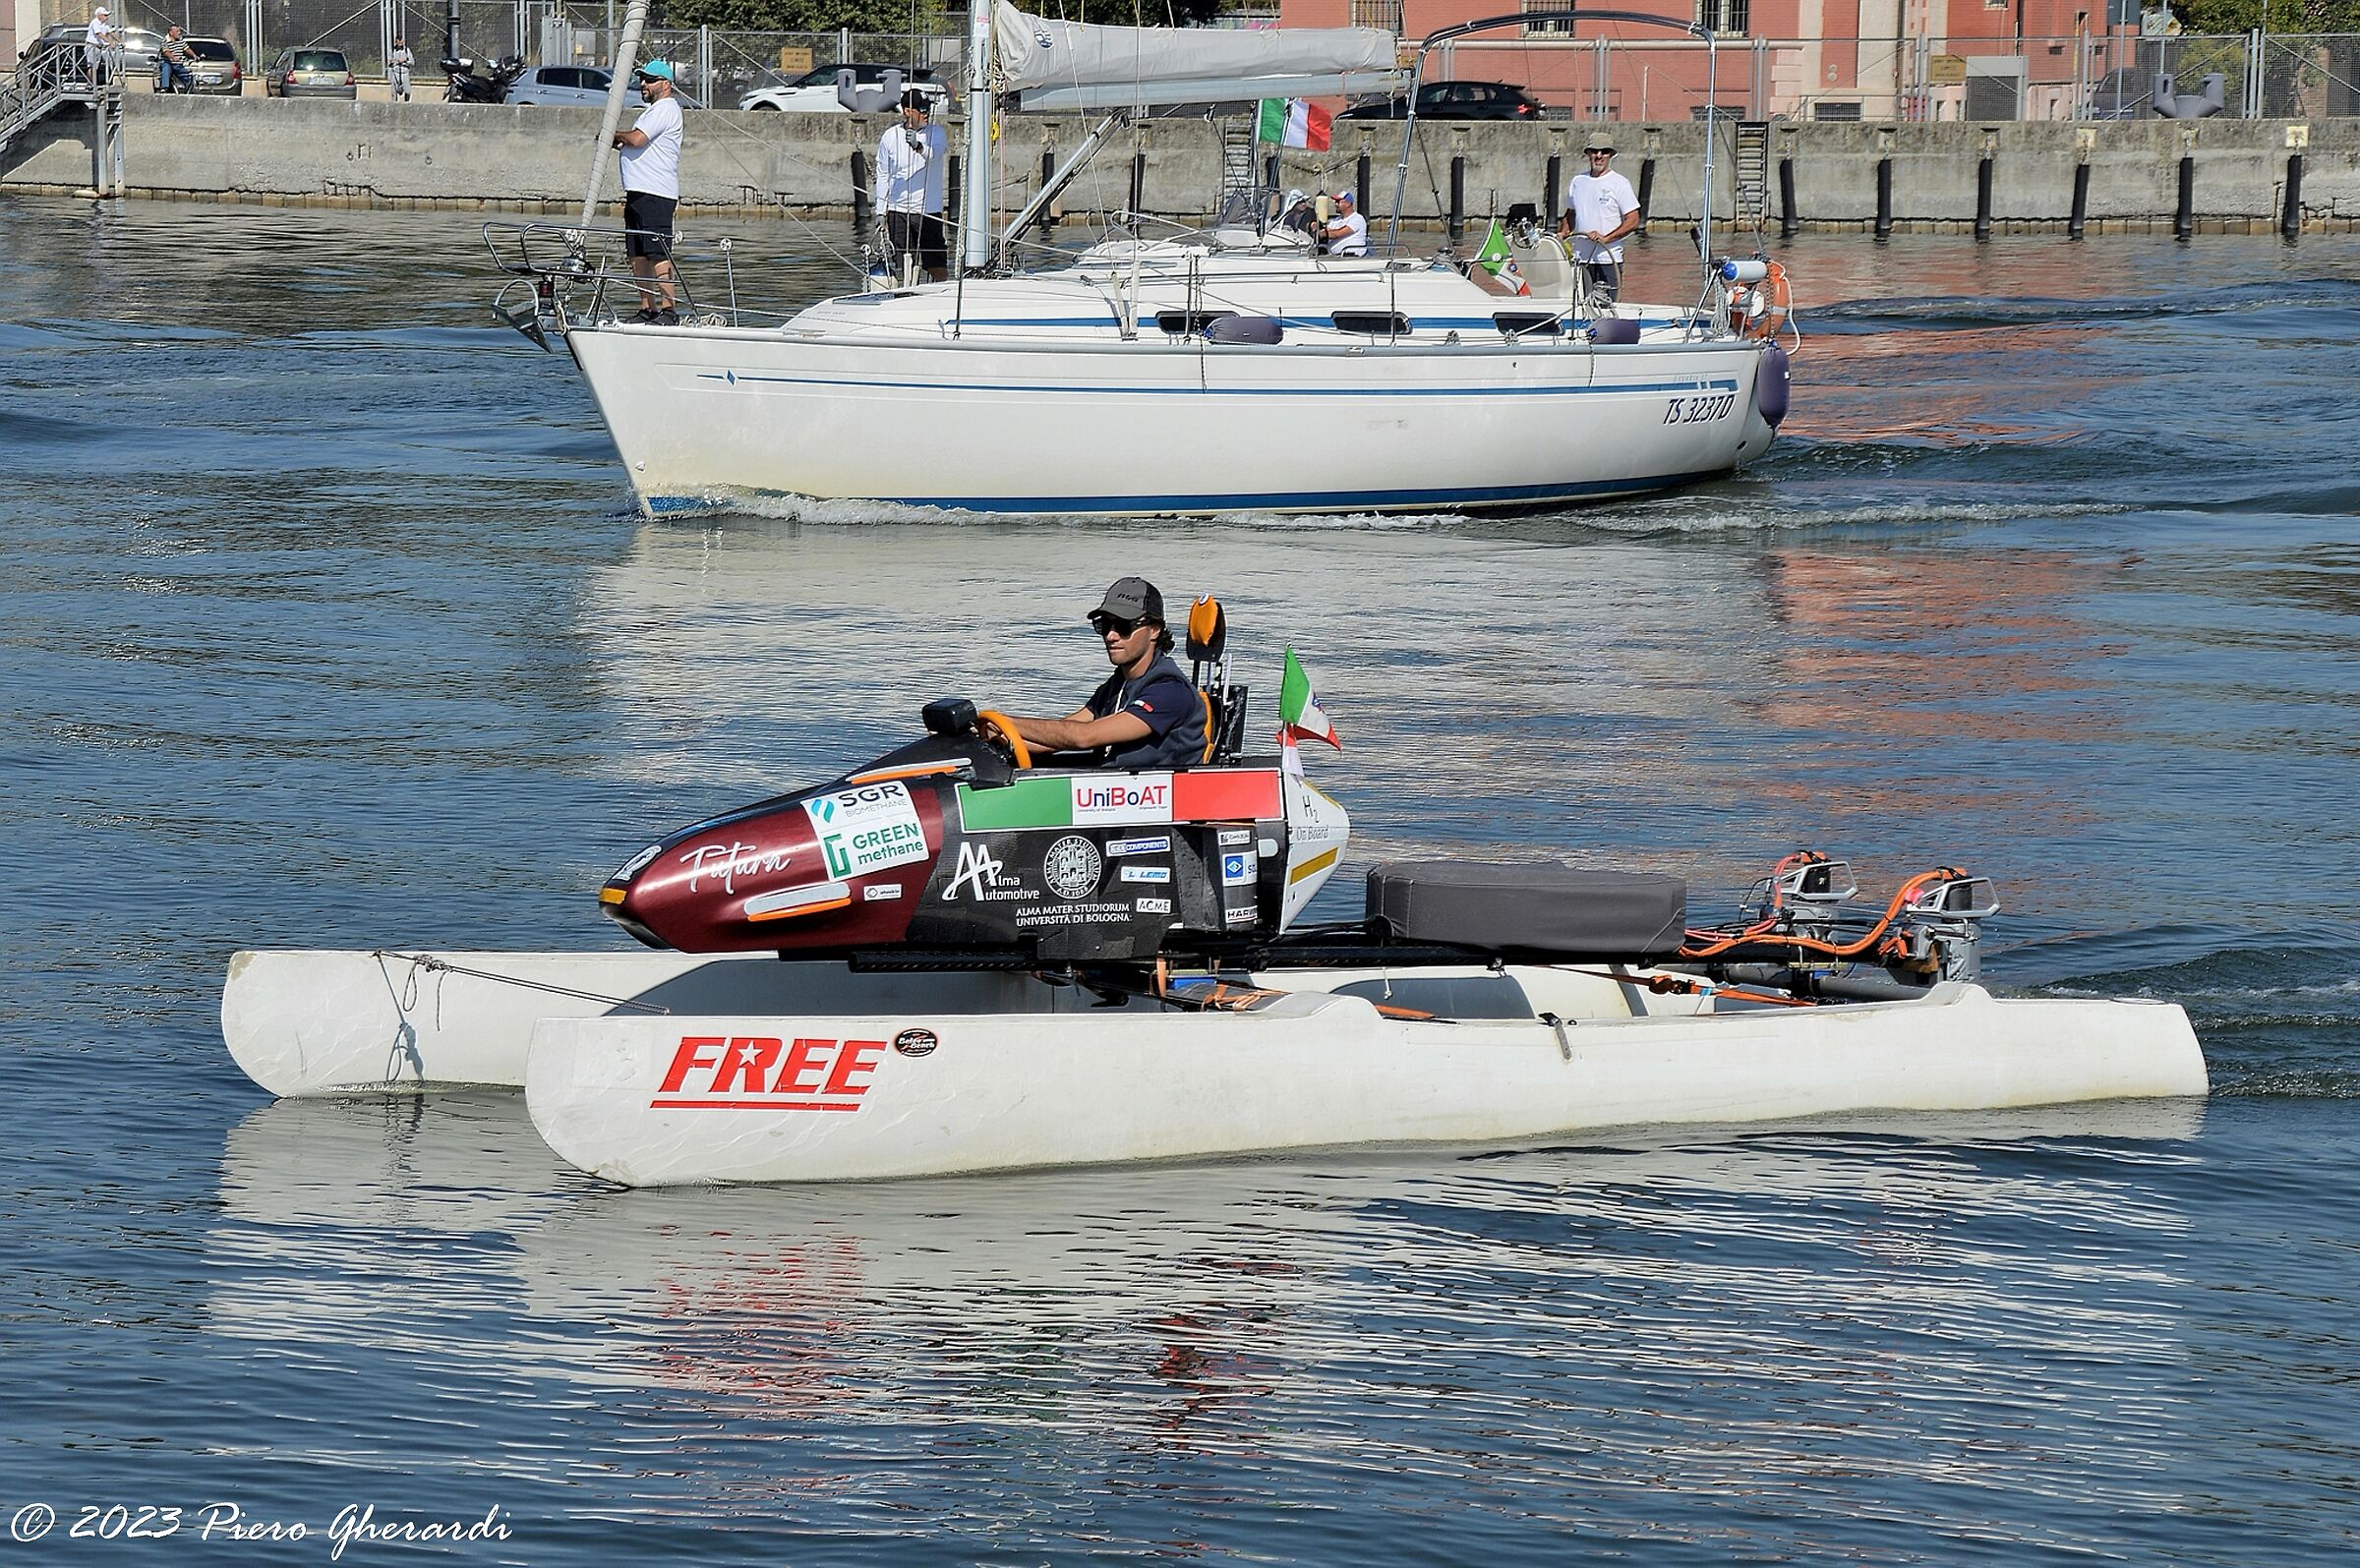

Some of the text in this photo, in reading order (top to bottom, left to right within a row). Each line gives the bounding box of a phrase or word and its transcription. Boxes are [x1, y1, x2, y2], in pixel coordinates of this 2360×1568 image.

[1663, 394, 1738, 425] TS 32370
[838, 784, 904, 808] SGR
[1077, 785, 1167, 807] UniBoAT
[846, 798, 909, 818] BIOMETHANE
[853, 823, 919, 849] GREEN
[857, 841, 924, 865] methane
[1016, 902, 1130, 917] ALMA MATER STUDIORUM
[1139, 900, 1170, 912] ACME
[1016, 913, 1071, 927] UNIVERSITÀ
[1073, 913, 1084, 924] DI
[658, 1037, 888, 1095] FREE
